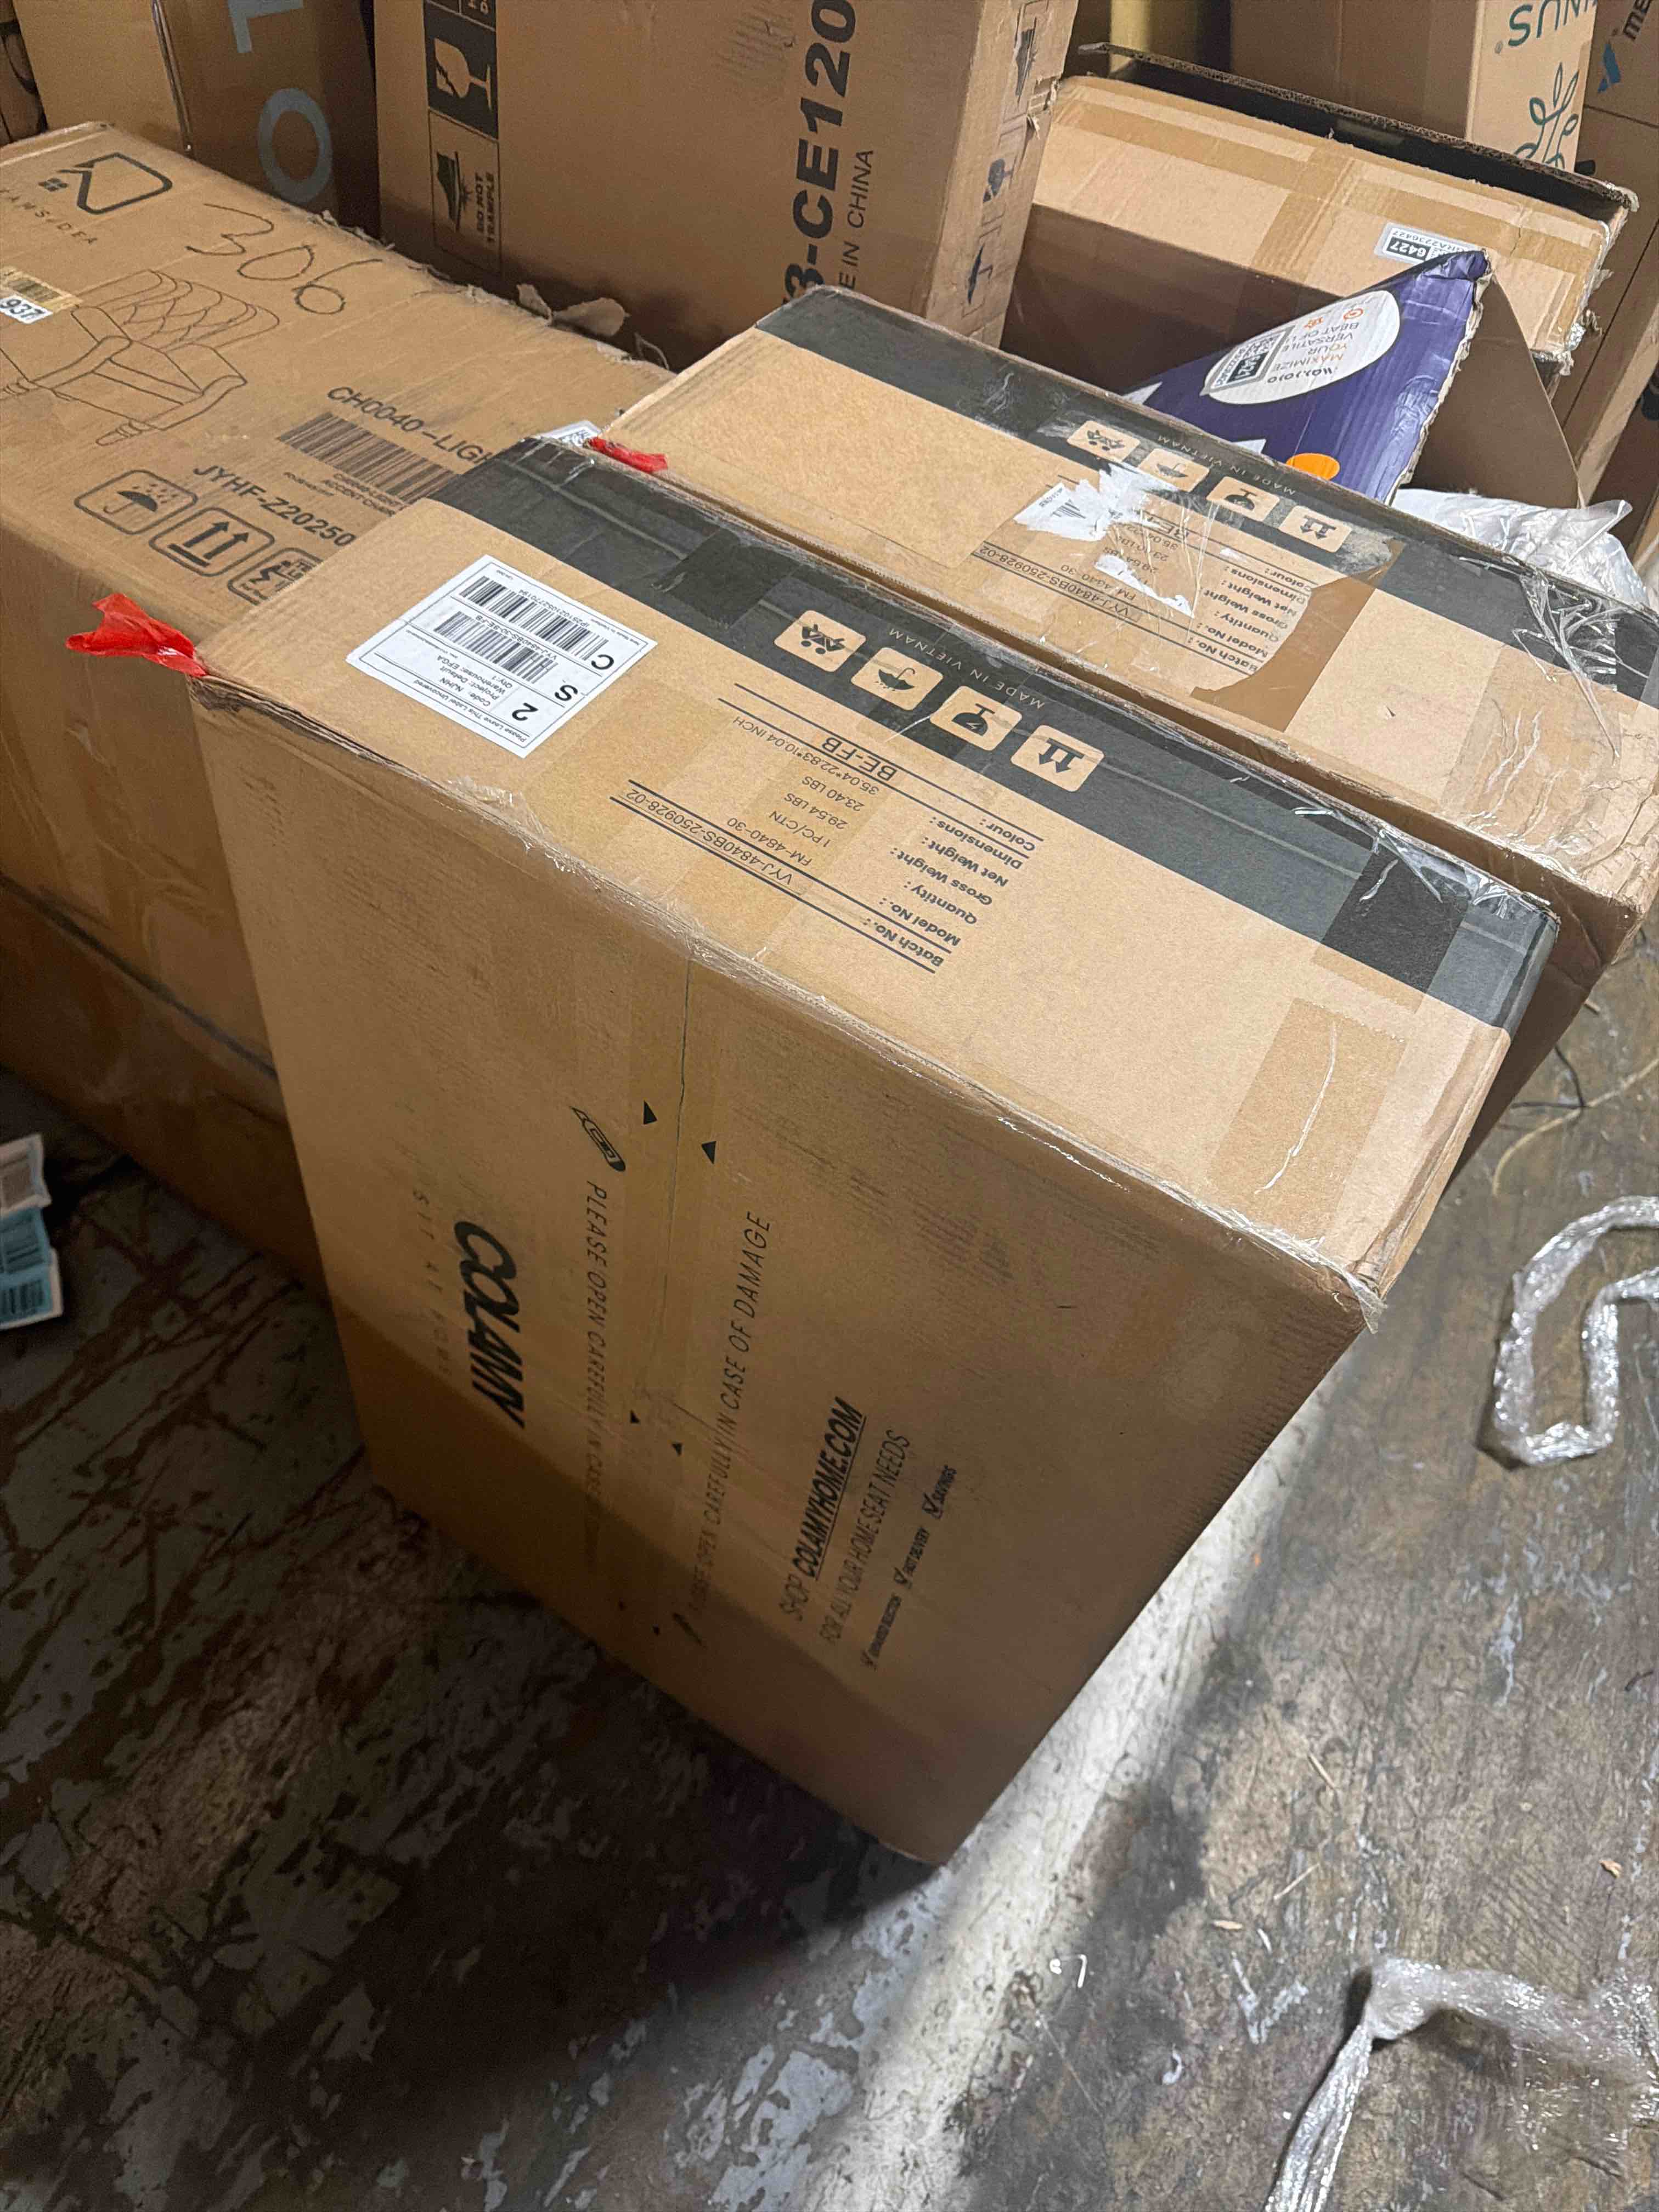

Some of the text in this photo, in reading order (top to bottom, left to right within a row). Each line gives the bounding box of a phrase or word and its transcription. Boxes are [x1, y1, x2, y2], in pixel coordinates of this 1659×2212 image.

[848, 149, 874, 229] CHINA
[843, 242, 861, 268] IN
[1390, 240, 1427, 257] 6427
[1281, 332, 1353, 352] VERSATILE
[1321, 322, 1359, 335] BEAT
[1272, 353, 1344, 371] MAXIMIZE
[1307, 343, 1348, 356] YOUR
[435, 654, 507, 695] Warehouse: EFGA
[591, 653, 614, 670] C
[889, 628, 1046, 711] MADE IN VIETNAM
[438, 665, 501, 700] Project: Default
[438, 676, 465, 692] NJHN
[554, 684, 578, 702] S
[411, 679, 528, 743] Please Leave This Label Uncovered
[511, 702, 539, 722] 2
[731, 716, 768, 737] INCH
[819, 735, 899, 781] BE-FB
[800, 775, 827, 792] LBS
[825, 787, 865, 812] 23.40
[782, 792, 809, 809] LBS
[766, 809, 825, 845] PC/CTN
[807, 805, 849, 830] 29.54
[623, 788, 797, 885] VYJ-4840BS-250928-02
[725, 816, 813, 866] FM-4840-30
[949, 878, 994, 906] Gross
[979, 867, 1009, 887] Net
[911, 915, 962, 946] Model
[896, 936, 945, 967] Batch
[586, 1180, 607, 1266] PLEASE
[733, 1211, 771, 1319] DAMAGE
[586, 1270, 607, 1331] OPEN
[454, 1220, 525, 1429] COLAMY
[727, 1320, 752, 1353] OF
[588, 1331, 607, 1427] CAREFULLY
[719, 1357, 747, 1410] CASE
[714, 1414, 737, 1437] IN
[874, 1429, 911, 1487] NEEDS
[779, 1396, 863, 1622] SHOP COLAMYHOME.COM
[860, 1482, 891, 1524] SEAT
[848, 1520, 879, 1562] HOME
[836, 1562, 862, 1598] YOUR
[819, 1616, 843, 1645] FOR
